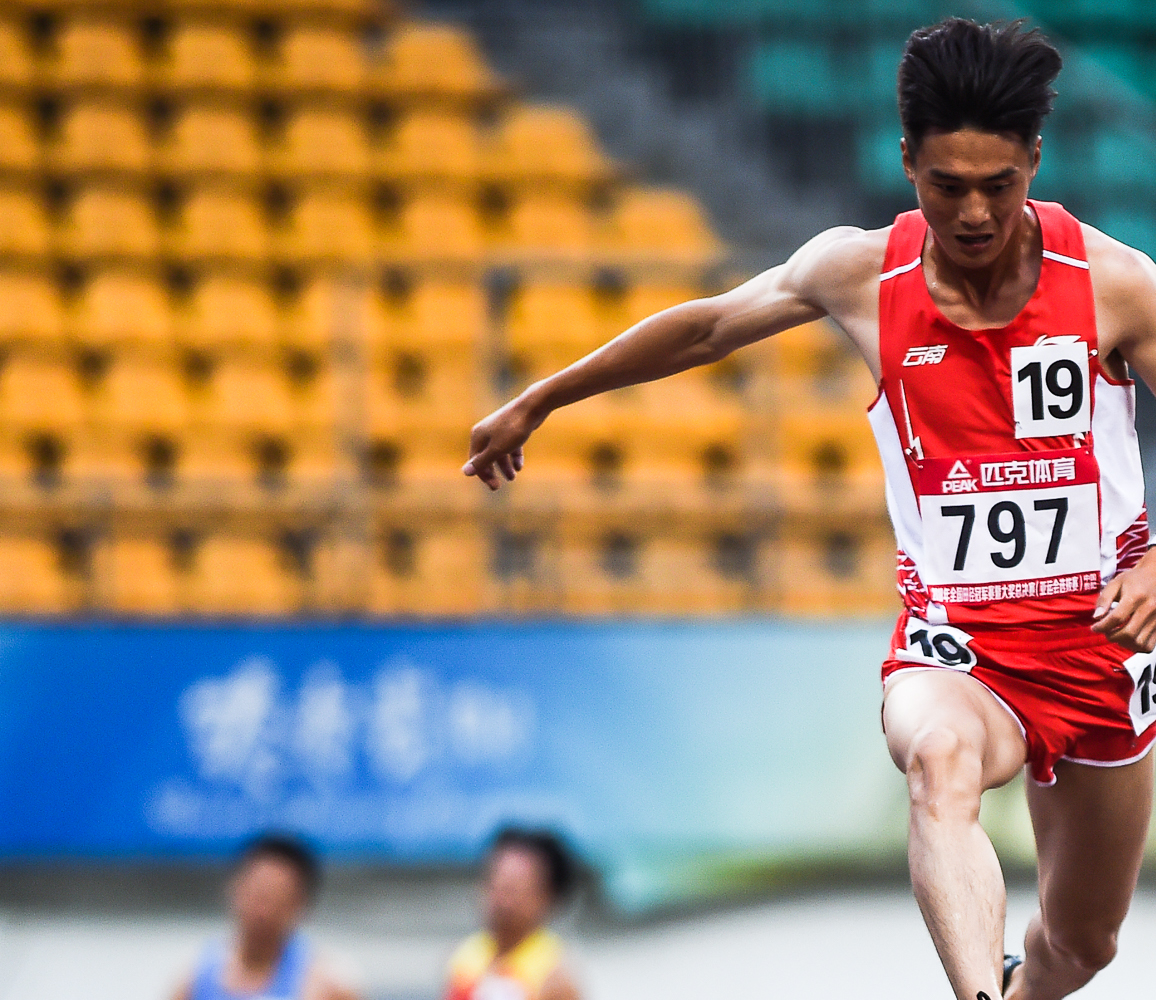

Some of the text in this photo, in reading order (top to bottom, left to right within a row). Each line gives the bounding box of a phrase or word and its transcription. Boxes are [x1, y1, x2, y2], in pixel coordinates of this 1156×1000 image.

[902, 344, 948, 367] 云南
[1017, 359, 1084, 420] 19
[942, 478, 978, 493] PEAK
[979, 457, 1076, 487] 匹克体育
[940, 497, 1069, 572] 797
[909, 628, 973, 666] 19
